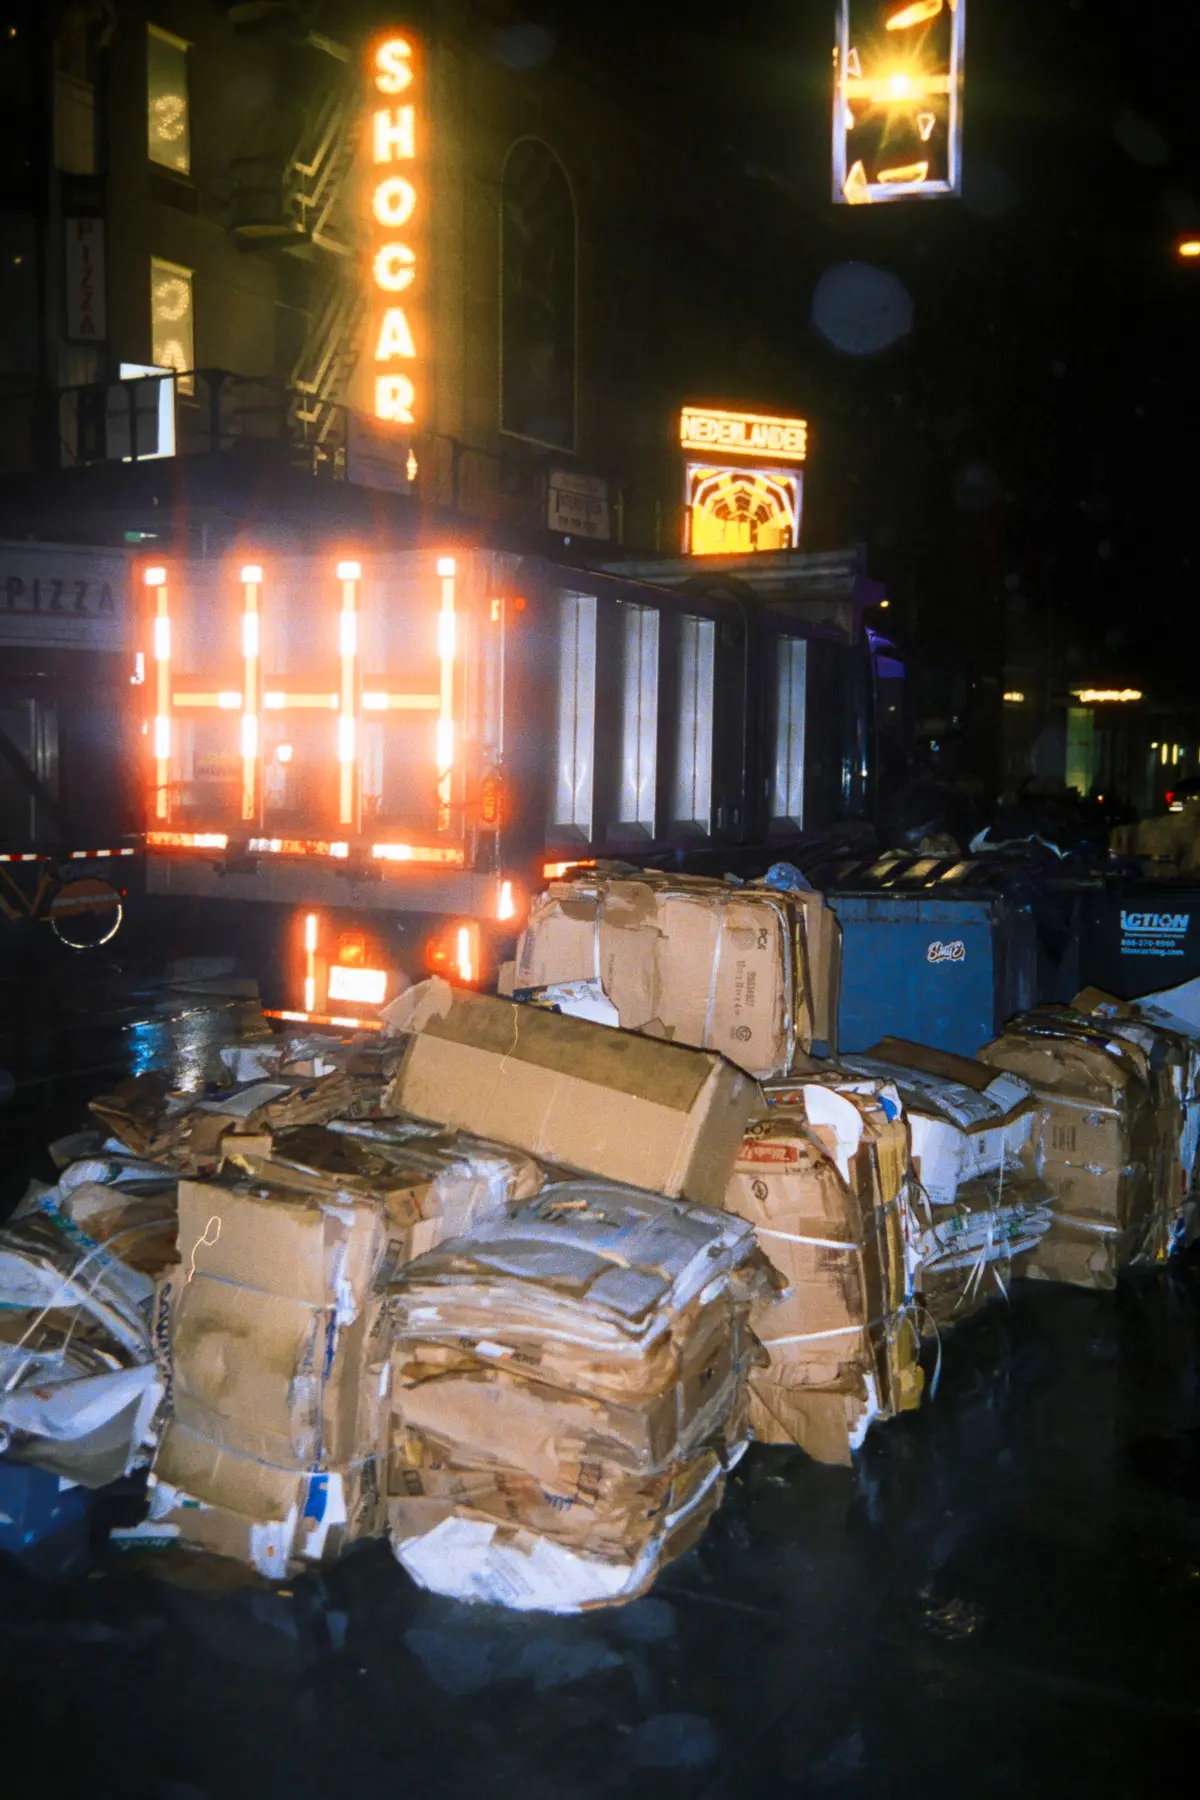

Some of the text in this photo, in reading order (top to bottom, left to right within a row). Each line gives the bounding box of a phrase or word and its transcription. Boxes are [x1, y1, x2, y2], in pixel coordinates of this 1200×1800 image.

[76, 221, 97, 335] PIZZA
[681, 415, 807, 451] NEDERLANDER
[6, 576, 113, 611] PIZZA
